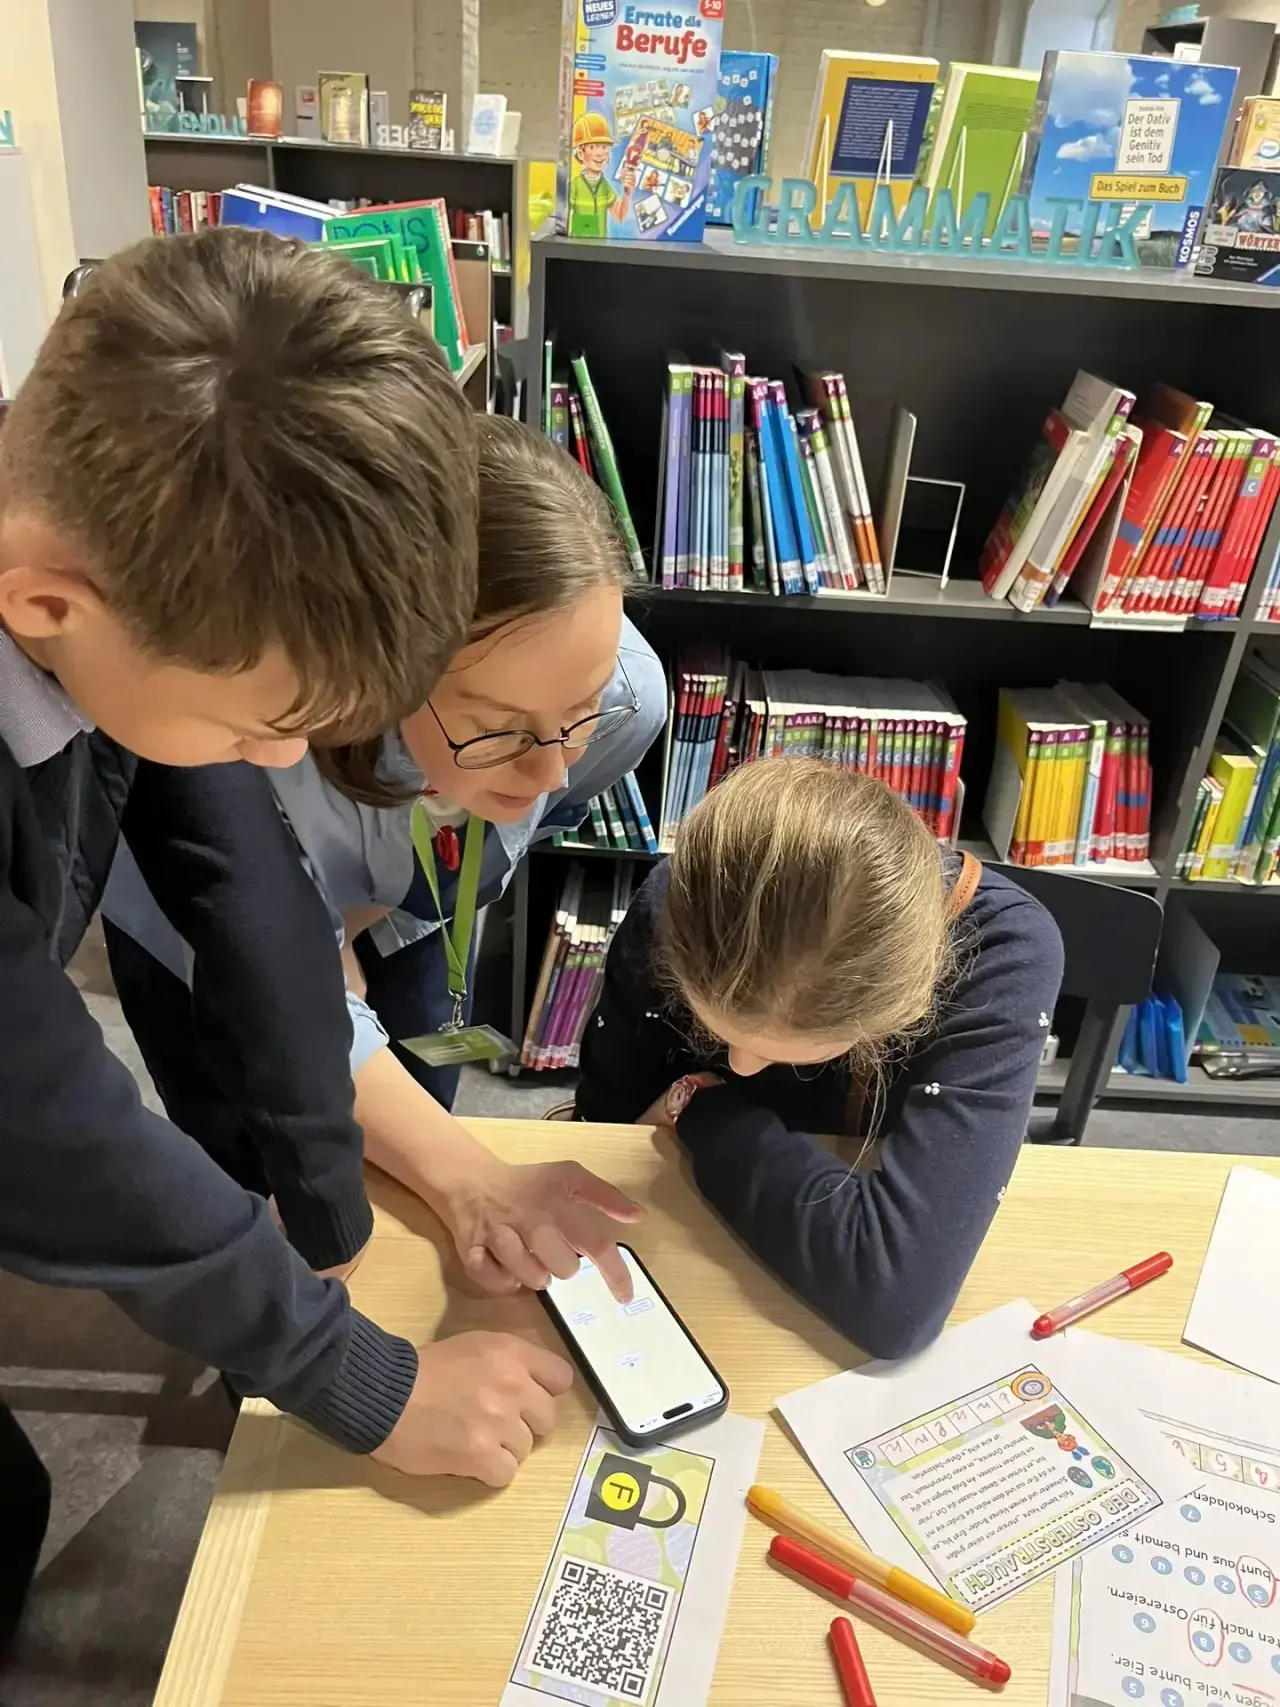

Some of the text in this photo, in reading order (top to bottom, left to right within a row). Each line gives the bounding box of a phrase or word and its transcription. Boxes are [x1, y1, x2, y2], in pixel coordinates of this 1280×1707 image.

[585, 0, 614, 14] NEUES
[625, 6, 702, 28] Errate die
[616, 24, 708, 64] Berufe
[1128, 113, 1171, 125] Der Dativ
[1130, 126, 1164, 138] ist dem
[1129, 139, 1161, 151] Genitiv
[1126, 153, 1163, 164] sein Tod
[1097, 180, 1180, 194] Das Spiel zum Buch
[731, 174, 1154, 270] GRAMMATIK
[1178, 210, 1200, 263] KOSMOS
[979, 1437, 992, 1446] eine
[1002, 1434, 1028, 1449] bemalten
[1025, 1445, 1034, 1453] ein
[951, 1465, 967, 1474] einen
[1005, 1466, 1027, 1478] Farben
[951, 1480, 967, 1491] Ende
[965, 1475, 976, 1483] Am
[1014, 1481, 1025, 1489] aus
[1026, 1475, 1039, 1484] Eier
[1039, 1475, 1068, 1493] Schwester
[609, 1481, 634, 1504] F
[977, 1480, 999, 1494] Danach
[1004, 1486, 1016, 1496] und
[1057, 1488, 1074, 1498] Felix
[899, 1492, 913, 1501] Das
[930, 1488, 953, 1501] hängen
[956, 1491, 977, 1504] müssen
[990, 1492, 1004, 1502] dann
[1026, 1491, 1038, 1501] und
[909, 1503, 921, 1512] alle
[921, 1498, 931, 1506] sie
[946, 1501, 956, 1509] die
[974, 1499, 991, 1510] malen
[1007, 1496, 1027, 1509] seinem
[1039, 1496, 1059, 1509] bemalt
[964, 1507, 974, 1515] die
[988, 1507, 1009, 1519] kleinen
[1021, 1507, 1040, 1518] heute
[1186, 1509, 1195, 1518] 7
[946, 1513, 965, 1526] Kinder
[924, 1528, 935, 1538] mit
[935, 1523, 945, 1531] sie
[952, 1529, 967, 1540] Erst
[963, 1487, 1139, 1594] DER OSTERSTRAUCH
[984, 1529, 995, 1539] mit
[966, 1535, 984, 1549] seiner
[1134, 1532, 1179, 1554] bemalt
[945, 1544, 965, 1559] großen
[1184, 1547, 1208, 1560] und
[1212, 1555, 1235, 1568] aus
[1118, 1548, 1263, 1600] 5 2 8 4 9
[1240, 1563, 1273, 1582] bunt
[1107, 1586, 1188, 1619] Ostereiern.
[1192, 1613, 1215, 1629] für
[1219, 1620, 1253, 1637] nach
[1138, 1617, 1245, 1659] 3 8 6
[1111, 1653, 1144, 1675] Eier.
[1149, 1666, 1191, 1690] bunte
[1127, 1682, 1177, 1707] 2 5
[1195, 1681, 1230, 1700] viele
